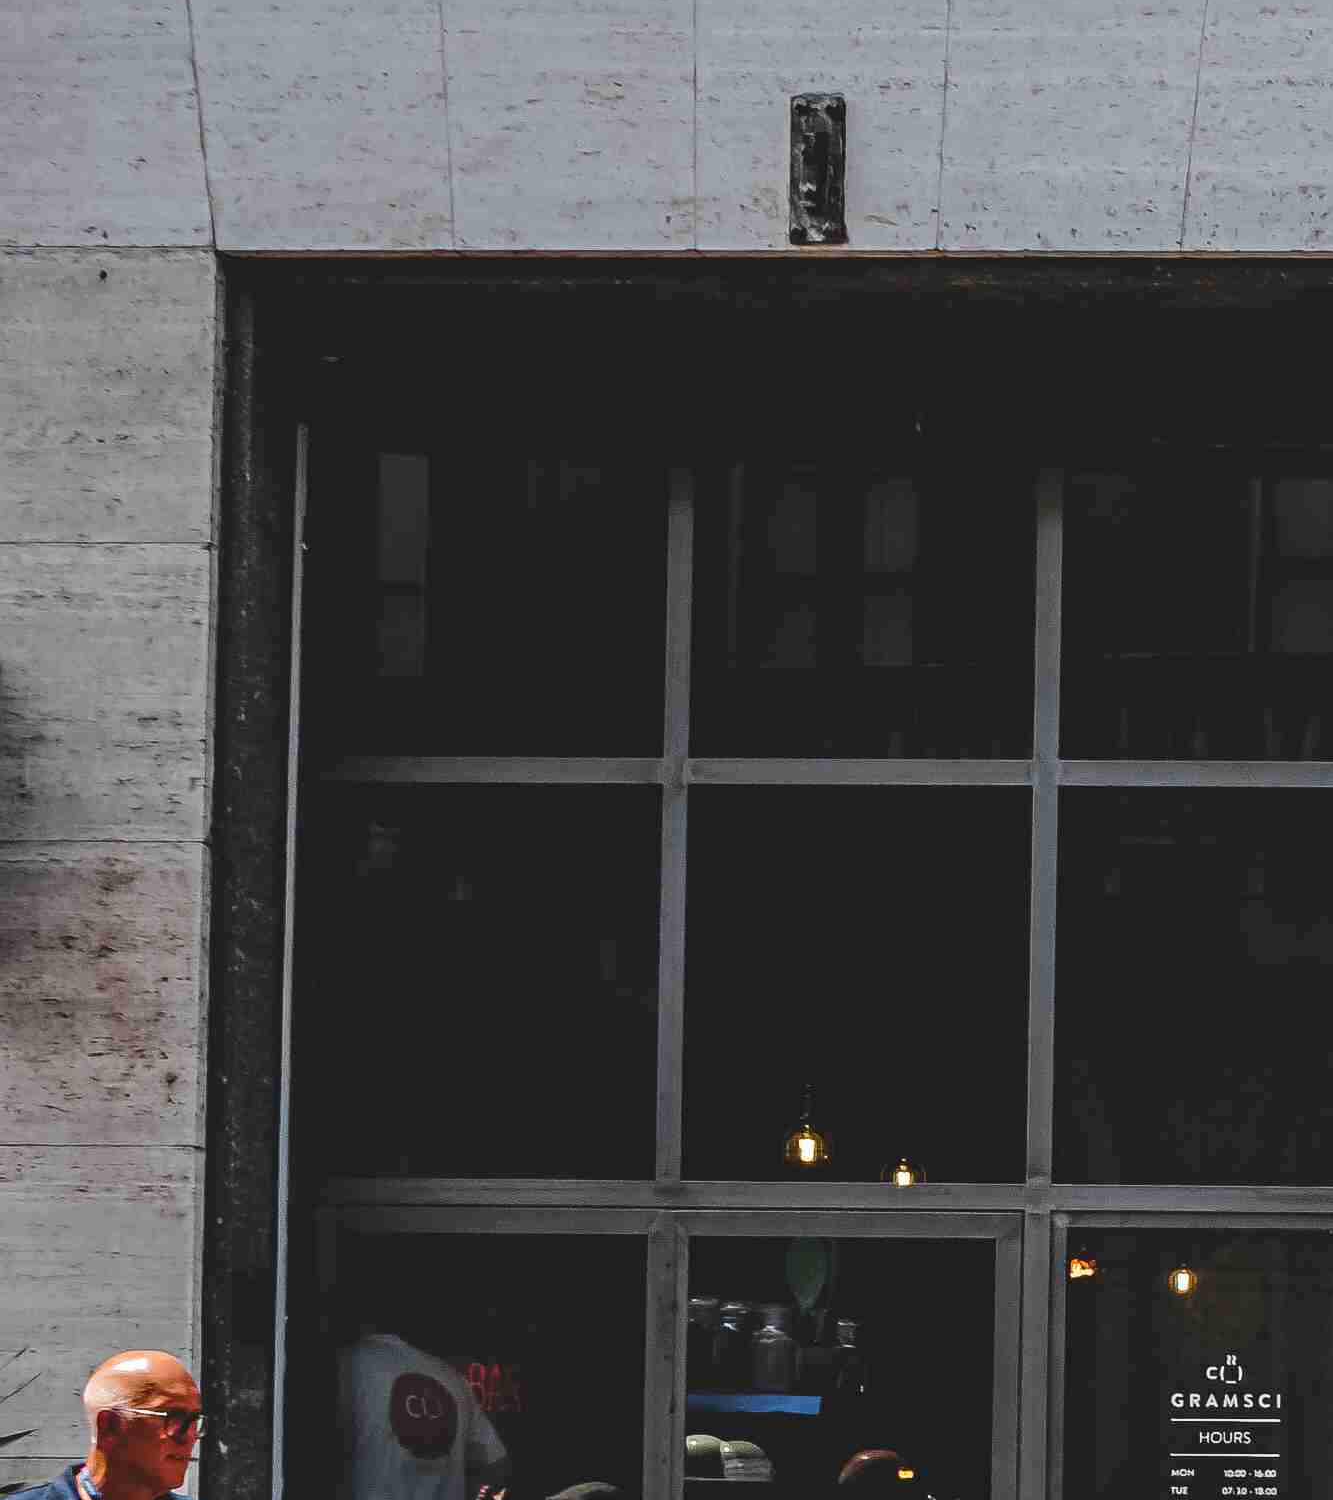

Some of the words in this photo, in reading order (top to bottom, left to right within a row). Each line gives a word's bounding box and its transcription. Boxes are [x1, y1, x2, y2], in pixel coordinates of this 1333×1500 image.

[1170, 1393, 1281, 1409] GRAMSCI
[1199, 1431, 1252, 1444] HOURS
[1171, 1468, 1195, 1477] MON
[1170, 1486, 1189, 1495] TUE
